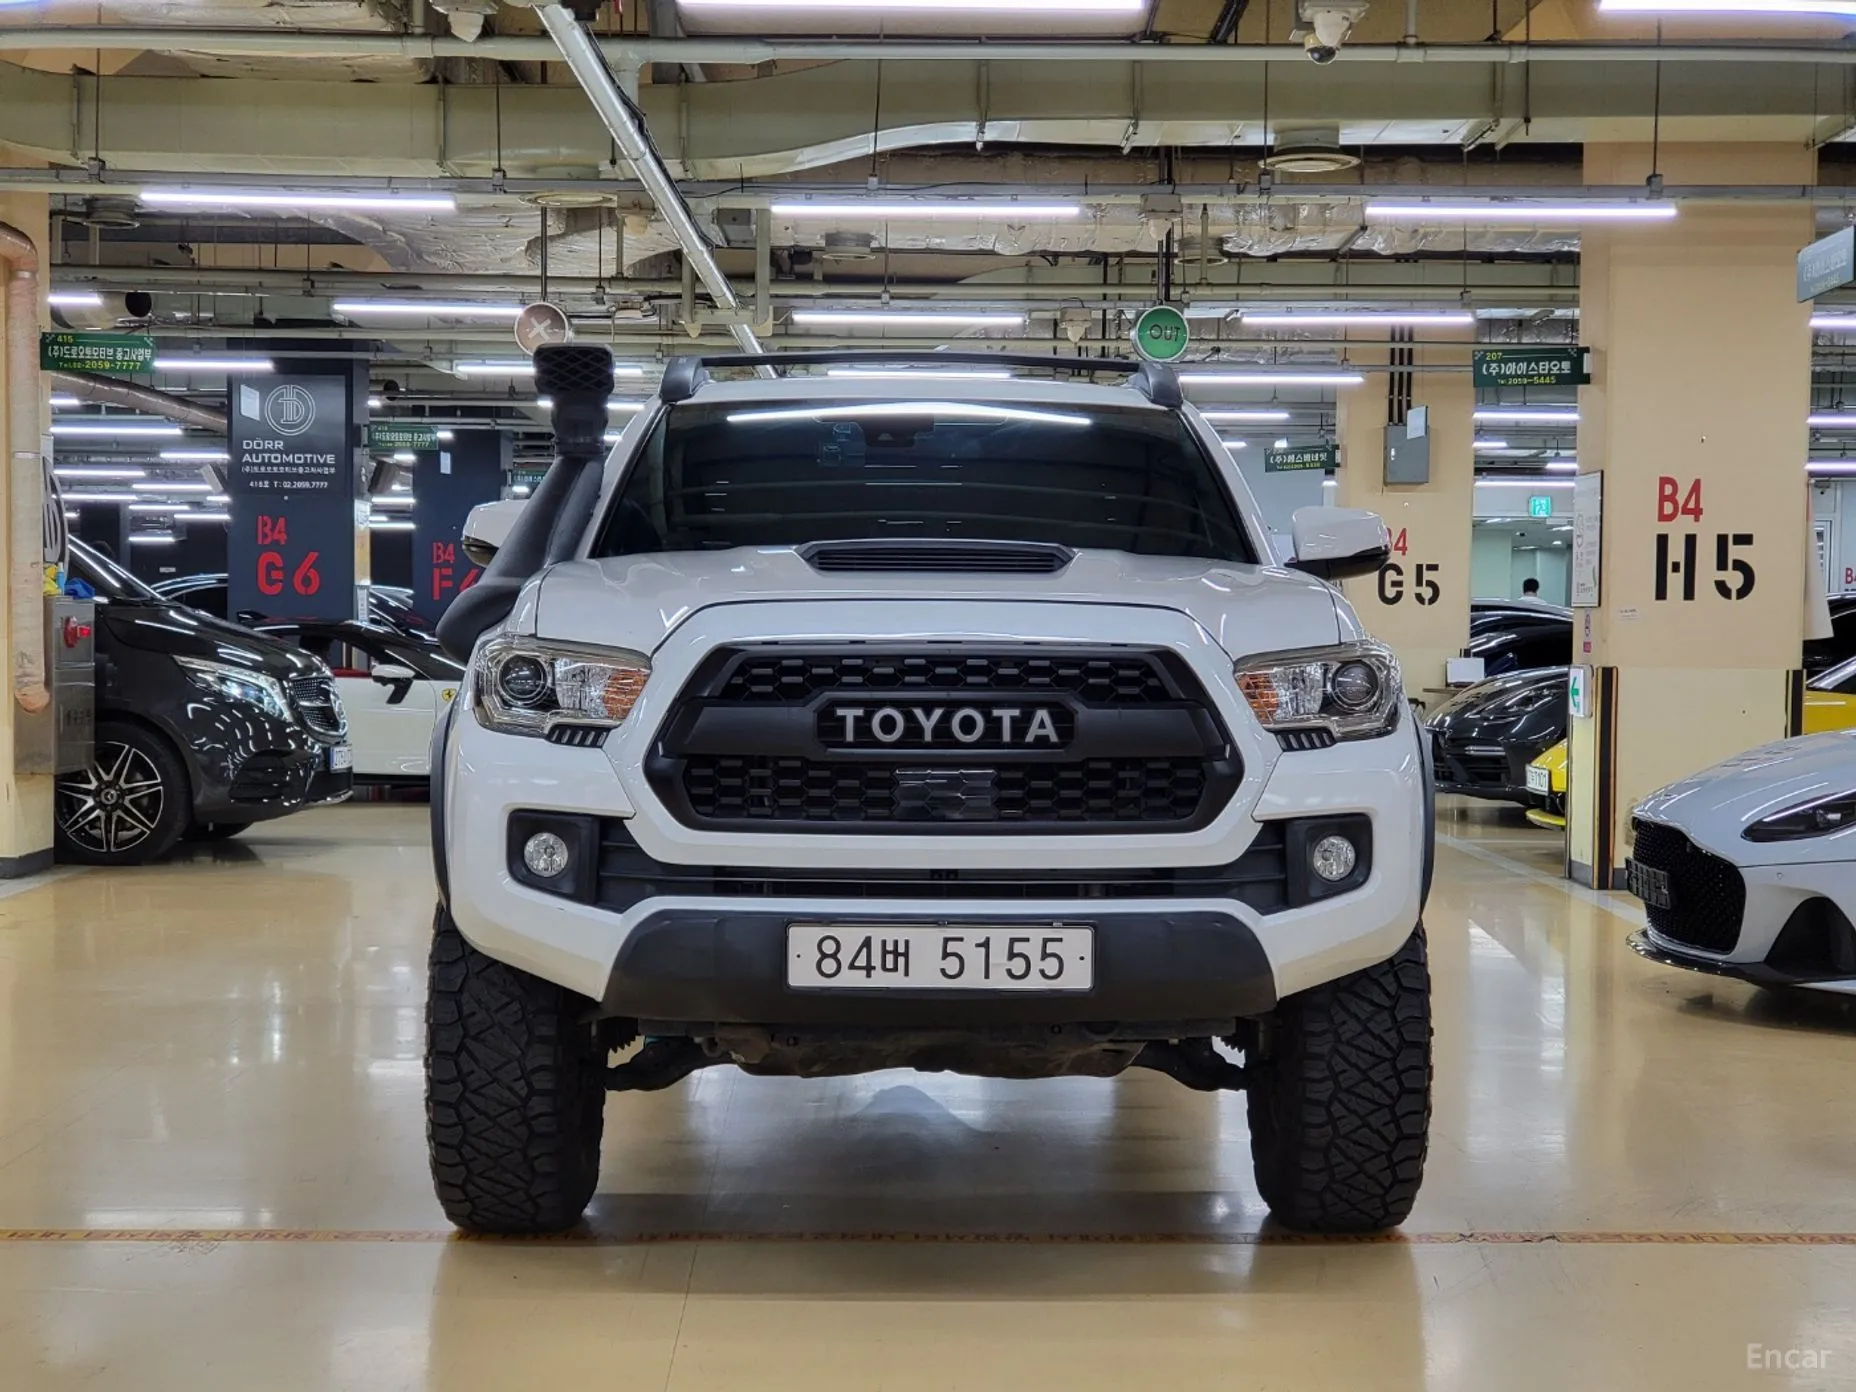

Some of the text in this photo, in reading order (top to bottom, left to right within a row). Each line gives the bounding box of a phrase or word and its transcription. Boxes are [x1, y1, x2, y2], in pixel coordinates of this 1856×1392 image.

[57, 335, 73, 343] 415
[1150, 324, 1180, 341] OUT
[1486, 352, 1502, 360] 207
[1482, 361, 1571, 375] (주)아이스타오토
[242, 437, 284, 450] DÖRR
[242, 453, 336, 464] AUTOMOTIVE
[1657, 476, 1704, 523] B4
[257, 515, 287, 545] B4
[1387, 527, 1408, 556] 4
[433, 542, 455, 564] B4
[1845, 567, 1856, 585] B
[836, 707, 1059, 743] TOYOTA
[815, 934, 1065, 981] 84버 5155
